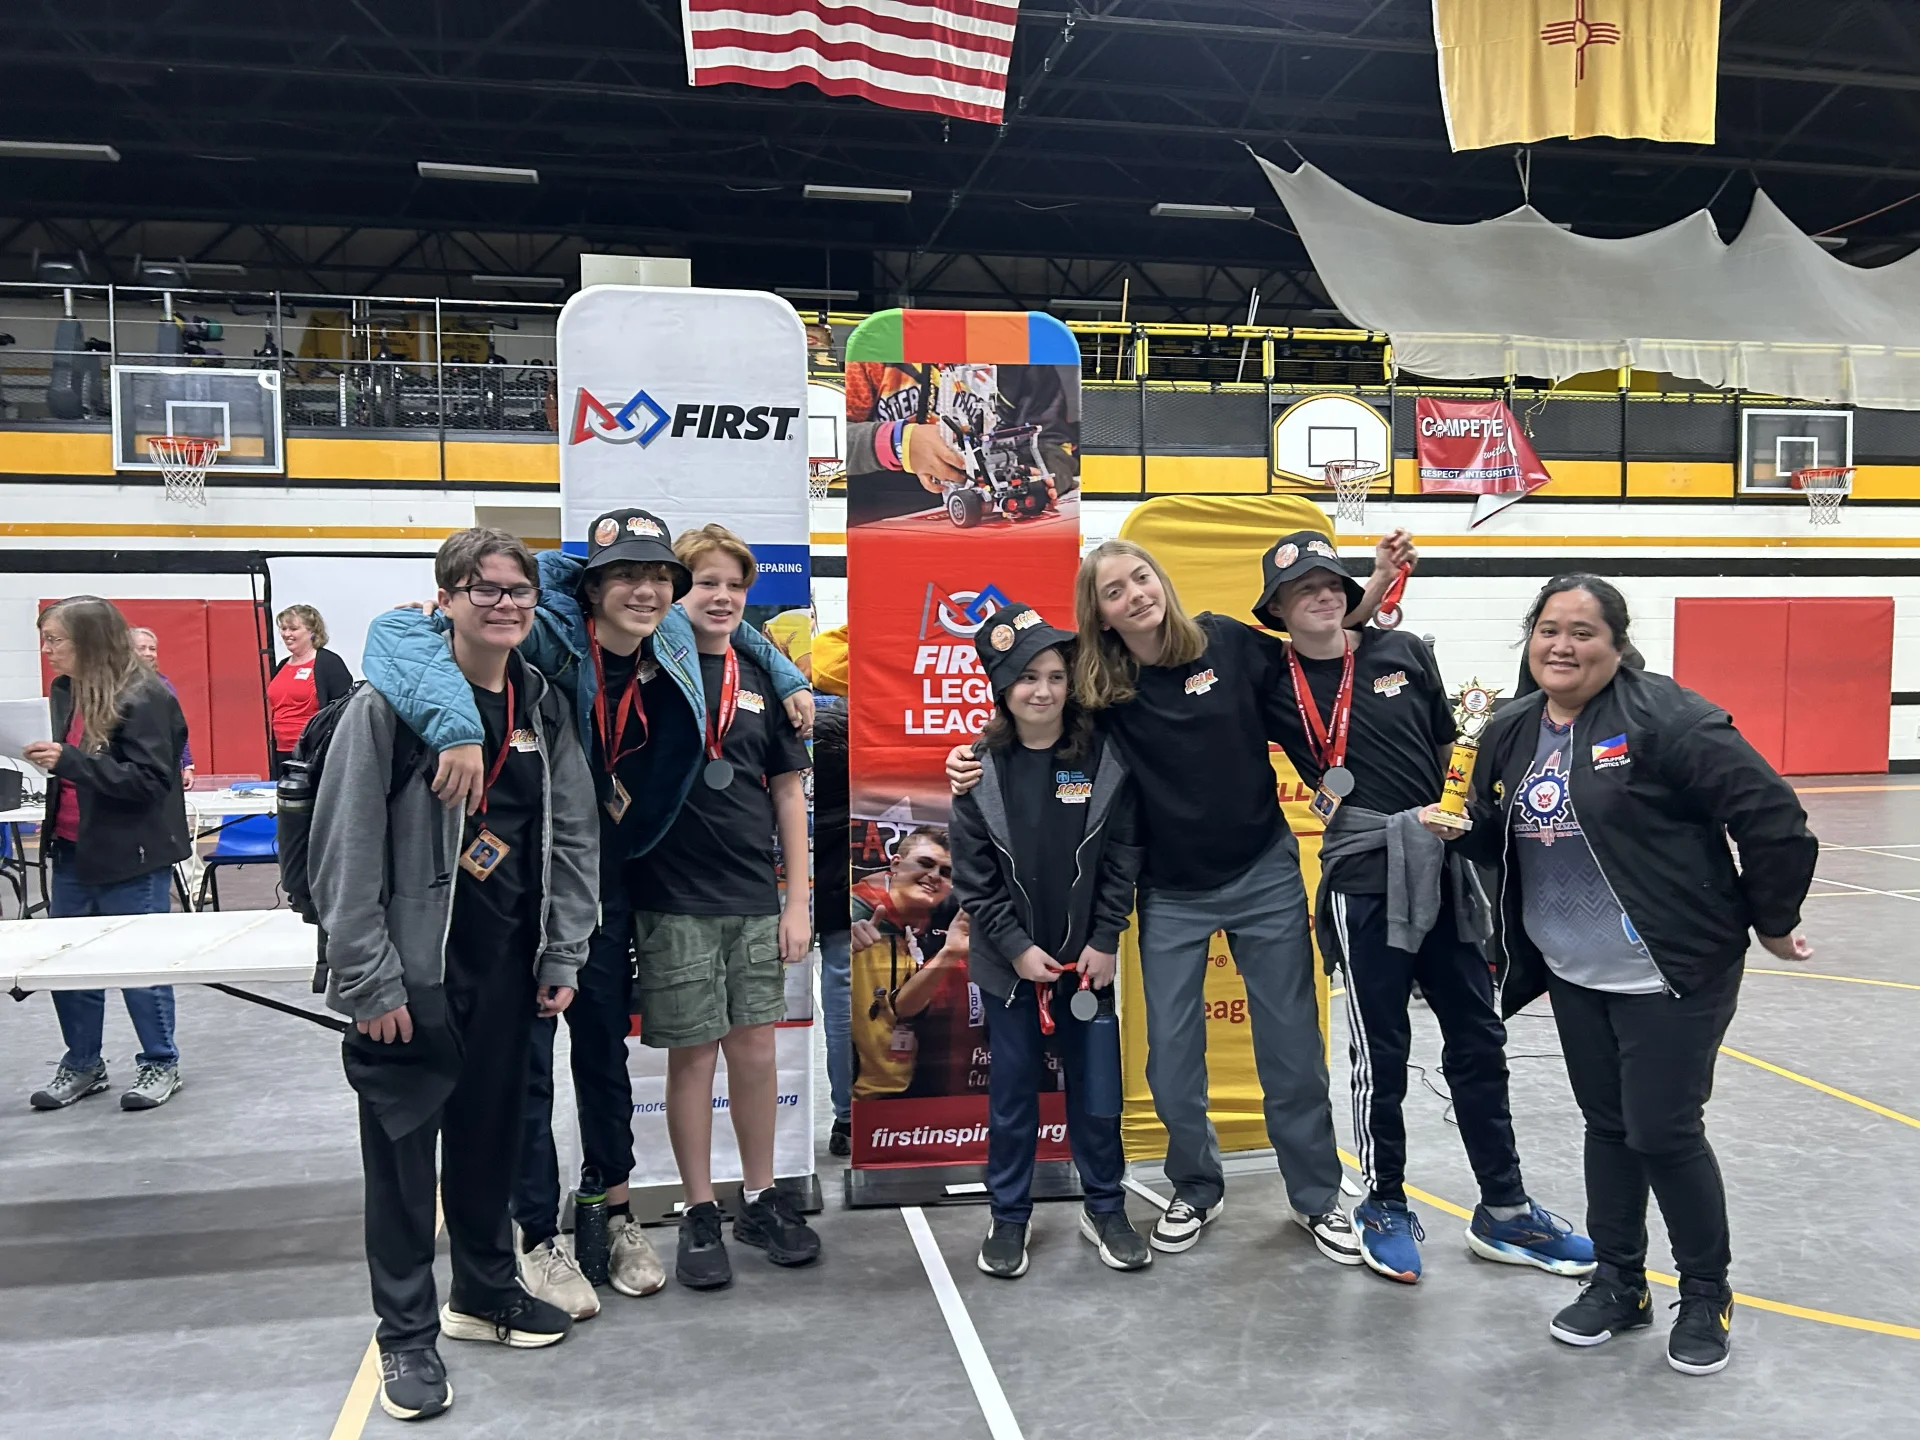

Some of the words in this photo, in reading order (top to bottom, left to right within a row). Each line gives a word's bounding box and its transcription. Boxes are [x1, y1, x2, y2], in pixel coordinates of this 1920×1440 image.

[671, 404, 800, 440] FIRST
[1483, 441, 1507, 460] with
[1465, 467, 1515, 479] INTEGRITY
[755, 563, 803, 573] REPARING
[913, 645, 987, 674] FIR
[905, 709, 996, 735] LEAG
[1277, 782, 1310, 802] LL
